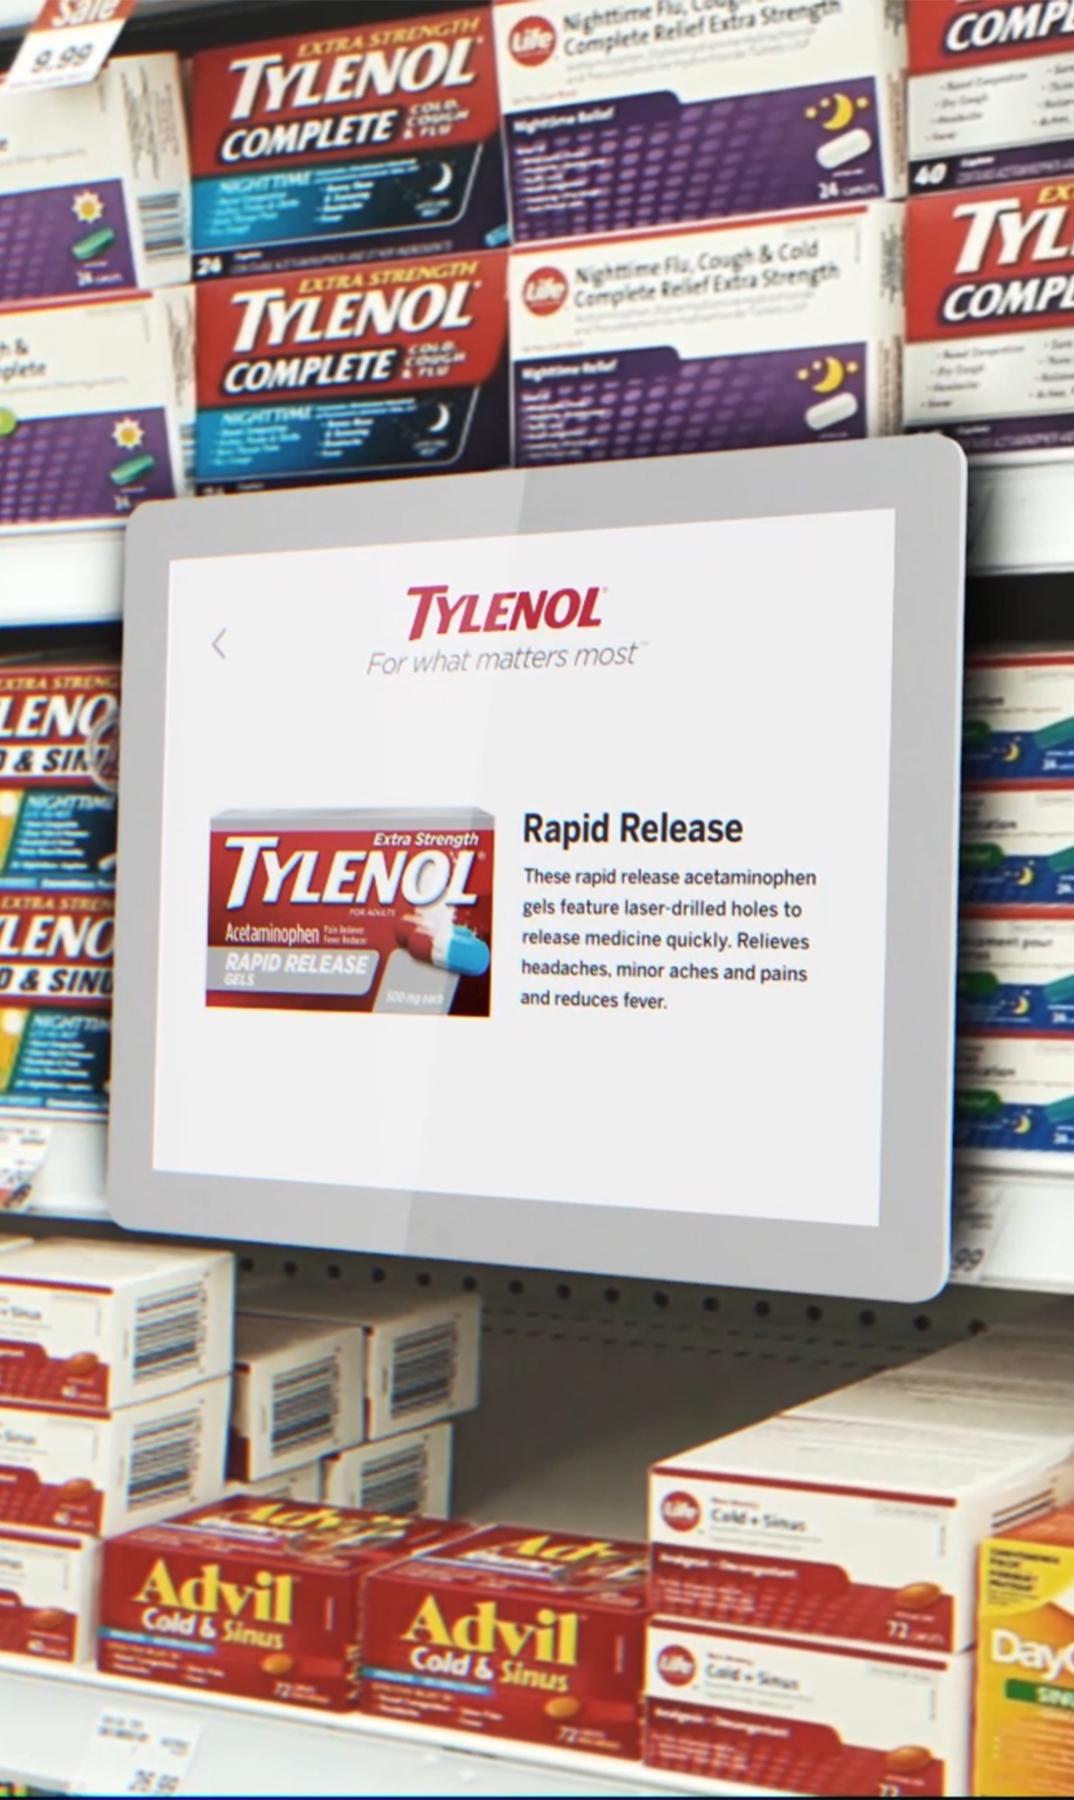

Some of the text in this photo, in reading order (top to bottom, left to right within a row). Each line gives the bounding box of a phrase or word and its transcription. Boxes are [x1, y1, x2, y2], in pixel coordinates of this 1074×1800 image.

[563, 5, 652, 33] Nighttime
[564, 0, 843, 57] Complete Relief Extra Strength
[298, 17, 480, 57] EXTRA STRENGTH
[511, 28, 554, 54] Life
[229, 37, 476, 120] TYLENOL
[221, 109, 398, 162] COMPLETE
[914, 162, 947, 185] 40
[952, 197, 1074, 275] TYL
[196, 256, 223, 276] 24
[299, 261, 479, 293] EXTRA STRENGTH
[575, 258, 660, 285] Nighttime
[698, 249, 756, 273] Cough
[759, 245, 773, 263] &
[778, 240, 819, 260] Cold
[574, 262, 840, 308] Complete Relief Extra Strength
[231, 280, 474, 352] TYLENOL
[223, 349, 397, 394] COMPLETE
[406, 585, 603, 641] TYLENOL
[366, 641, 639, 676] For what matters most
[14, 748, 33, 772] &
[373, 831, 480, 848] Extra Strength
[523, 811, 744, 851] Rapid Release
[224, 836, 479, 911] TYLENOL
[524, 867, 818, 890] These rapid release acetaminophen
[522, 898, 803, 918] gels feature laser-drilled holes to
[0, 915, 114, 959] LENO
[225, 922, 320, 946] Acetaminophen
[522, 929, 810, 952] release medicine quickly. Relieves
[19, 968, 39, 991] &
[224, 973, 256, 987] GELS
[225, 952, 370, 976] RAPID RELEASE
[521, 959, 808, 984] headaches, minor aches and pains
[386, 990, 405, 1004] 500
[520, 990, 668, 1010] and reduces fever.
[710, 1508, 807, 1533] Cold + Sinus
[132, 1558, 294, 1625] Advil
[141, 1608, 285, 1651] Cold & Sinus
[400, 1593, 579, 1667] Advil
[410, 1646, 570, 1693] Cold & Sinus
[705, 1664, 740, 1683] Cold
